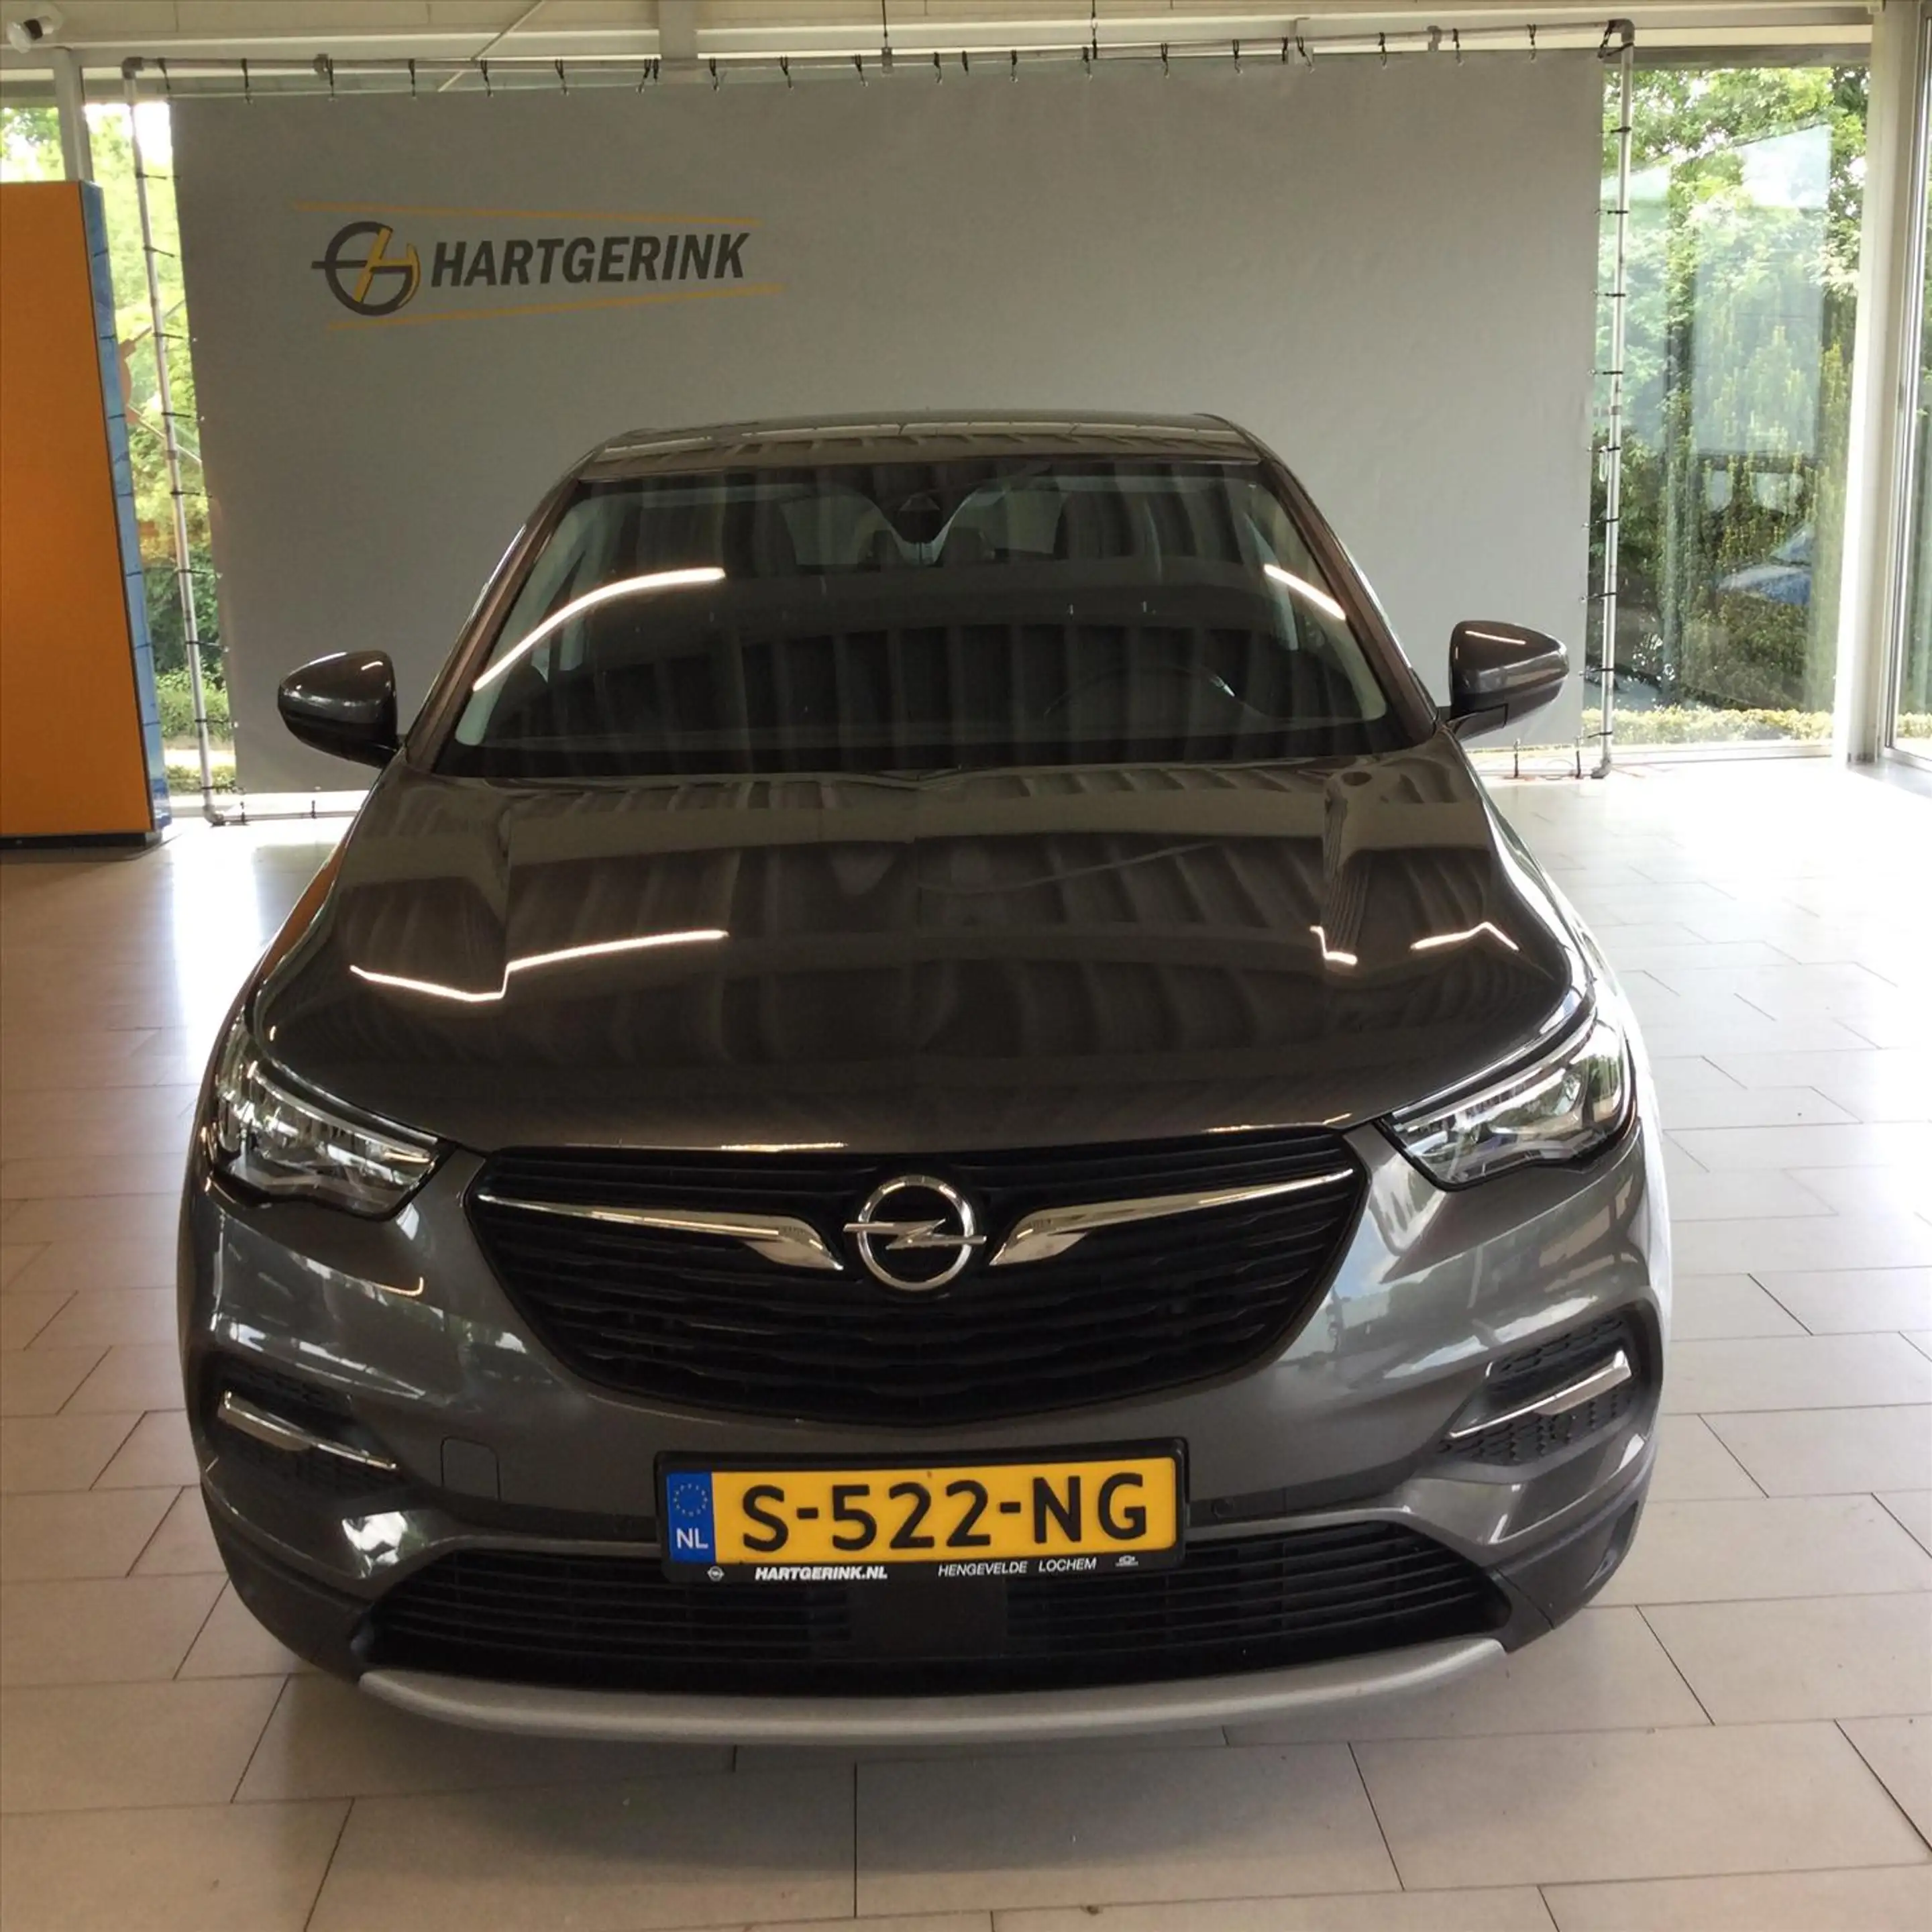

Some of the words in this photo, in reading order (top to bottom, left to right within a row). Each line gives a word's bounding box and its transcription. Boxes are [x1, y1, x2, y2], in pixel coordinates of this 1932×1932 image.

[431, 233, 750, 287] HARTGERINK
[741, 1472, 1147, 1552] S-522-NG
[676, 1527, 708, 1550] NL
[755, 1565, 888, 1581] HARTGERINK.NL
[938, 1560, 1028, 1576] HENGEVELDE
[1038, 1556, 1097, 1573] LOCHEM
